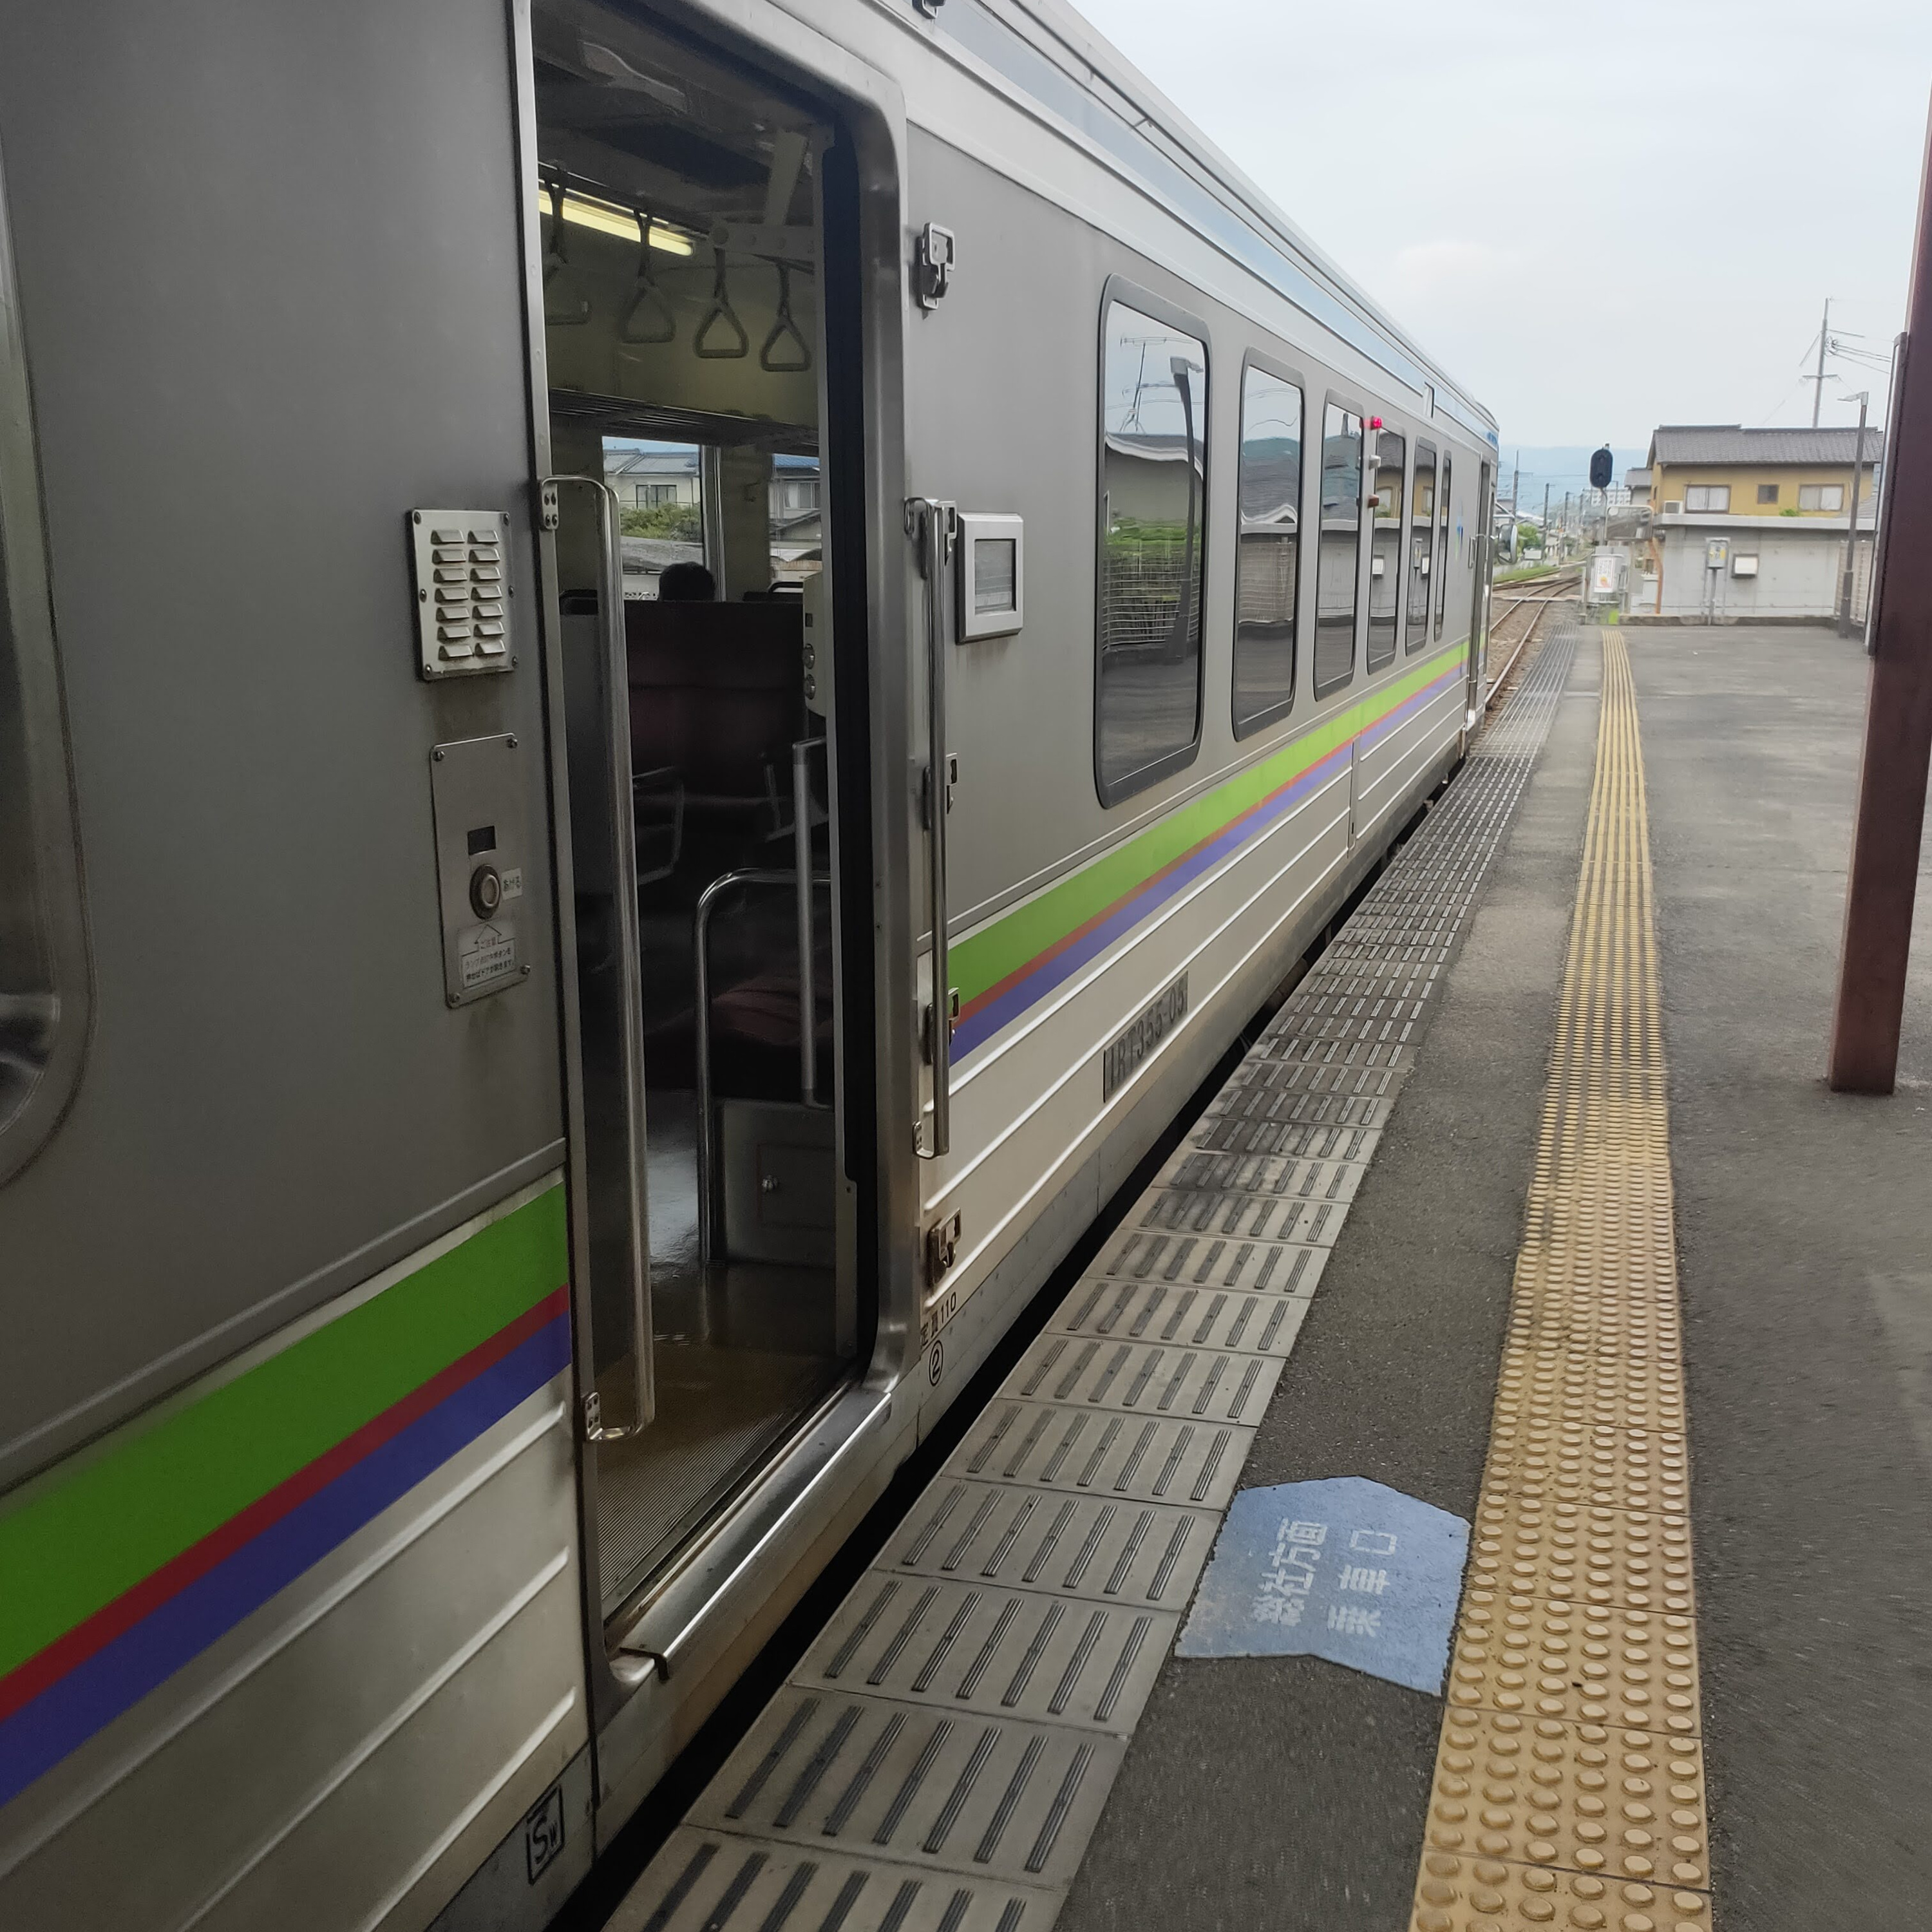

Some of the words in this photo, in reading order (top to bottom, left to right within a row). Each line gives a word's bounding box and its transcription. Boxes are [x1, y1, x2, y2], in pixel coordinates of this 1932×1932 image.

[1110, 977, 1184, 1091] IRT355-05
[1327, 1530, 1397, 1637] 乗車口
